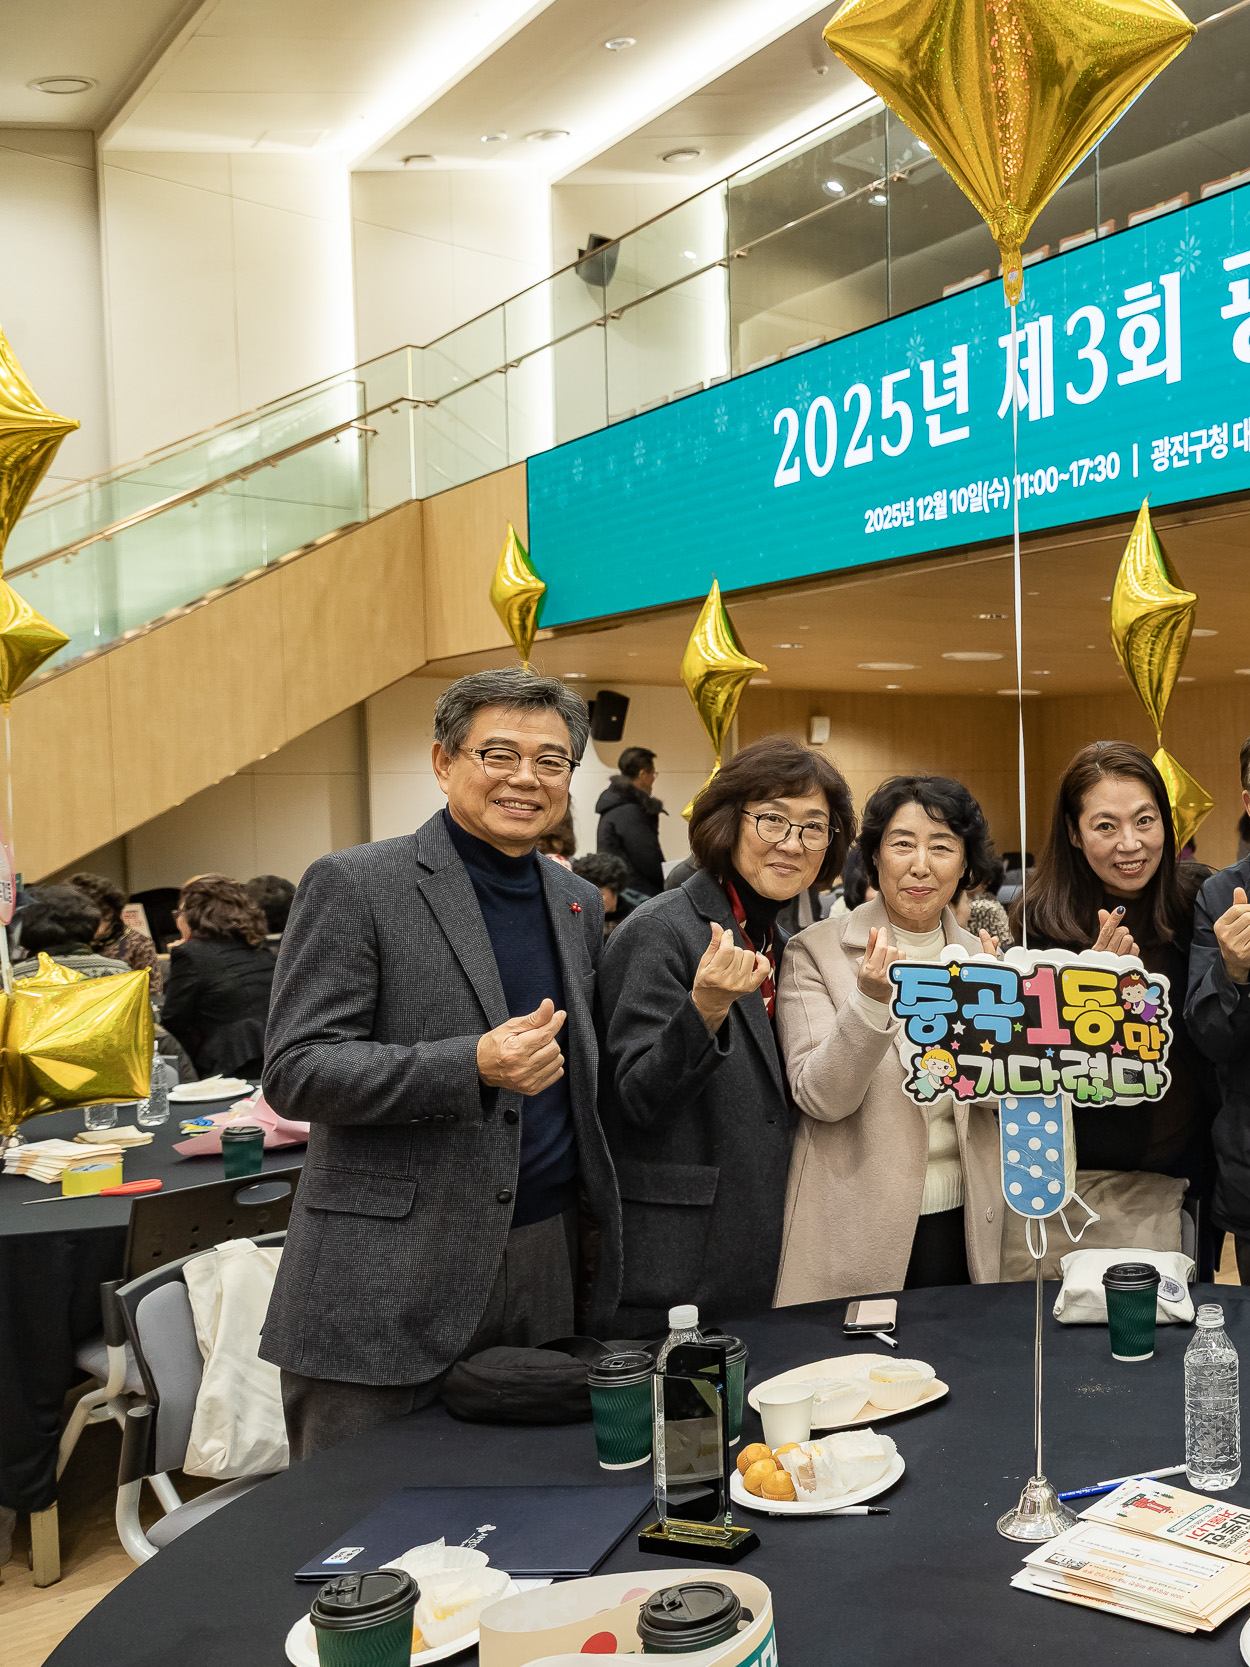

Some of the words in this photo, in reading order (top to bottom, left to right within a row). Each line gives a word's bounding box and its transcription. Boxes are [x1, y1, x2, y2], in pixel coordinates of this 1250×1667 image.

[773, 343, 970, 488] 2025년
[996, 271, 1183, 422] 제3회
[864, 492, 915, 534] 2025년
[917, 488, 948, 522] 12월
[948, 476, 1011, 515] 10일(수)
[1012, 450, 1121, 500] 11:00~17:30
[1150, 422, 1229, 472] 광진구청
[956, 1049, 1164, 1102] 기다렸다
[1185, 1509, 1238, 1540] 겨울나기
